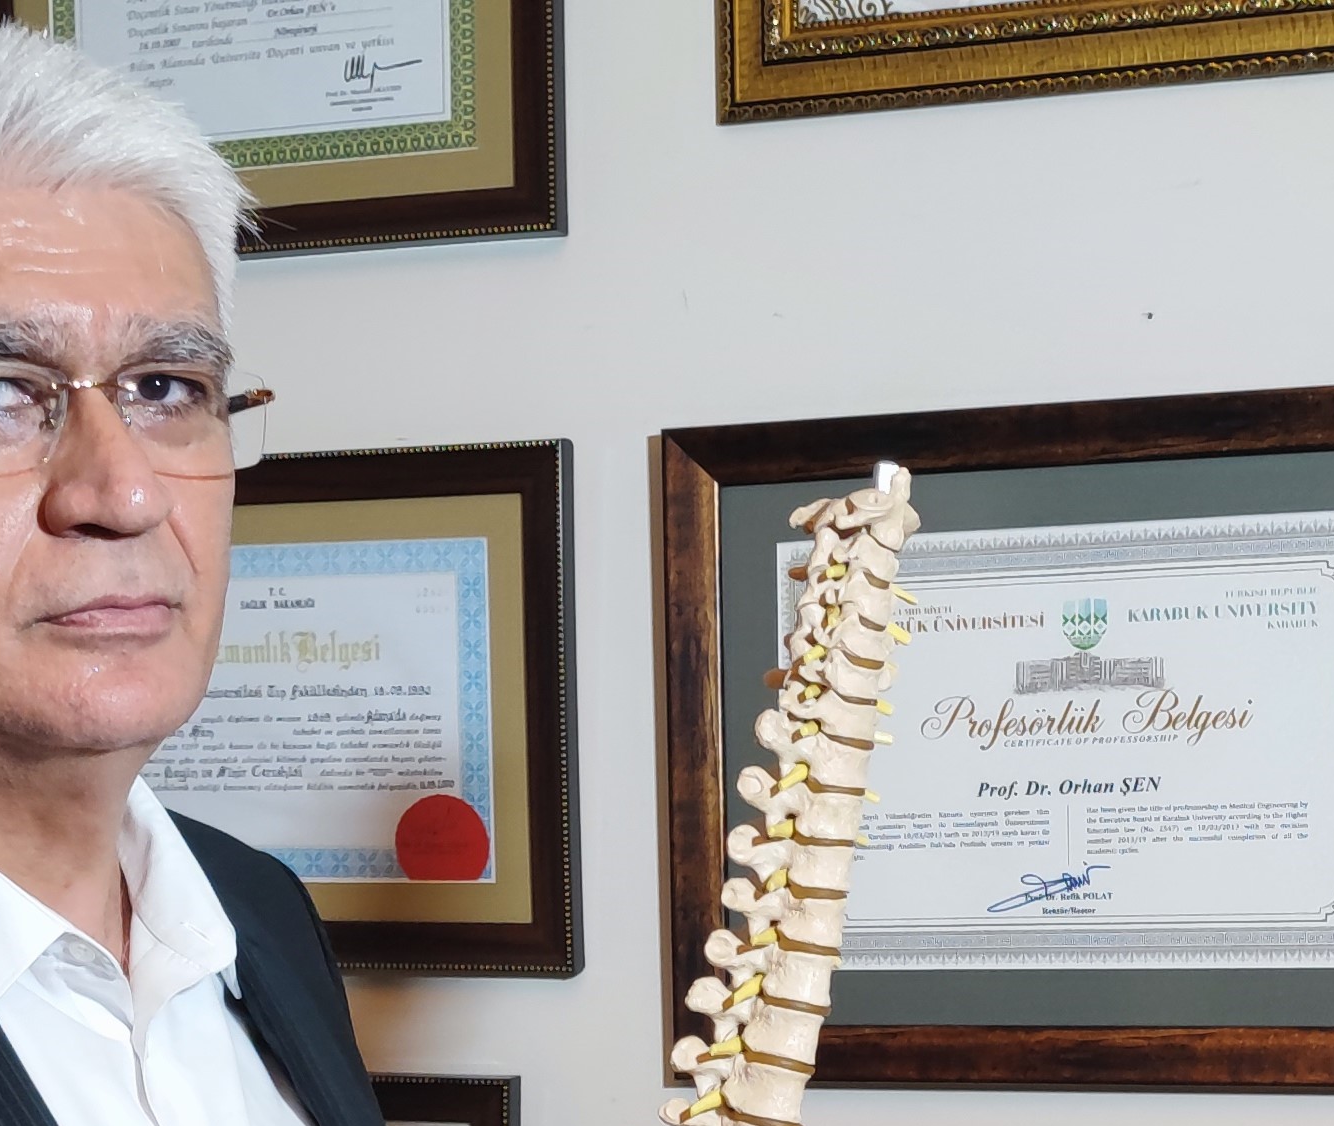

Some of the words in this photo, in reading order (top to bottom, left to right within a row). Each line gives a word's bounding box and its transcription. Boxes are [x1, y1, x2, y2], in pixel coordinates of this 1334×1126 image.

[933, 612, 1045, 633] ÜNİVERSİTESİ
[1128, 606, 1208, 623] KARABUK
[1214, 601, 1317, 618] UNIVERSITY
[920, 695, 1106, 751] Profesörlük
[1122, 687, 1254, 747] Belgesi
[1003, 738, 1072, 748] CERTIFICATE
[1075, 737, 1090, 745] OF
[1092, 734, 1179, 745] PROFESSORSHIP
[977, 781, 1019, 800] Prof.
[1025, 780, 1052, 797] Dr.
[1058, 779, 1115, 795] Orhan
[1119, 776, 1162, 796] ŞEN
[1083, 892, 1113, 900] POLAT
